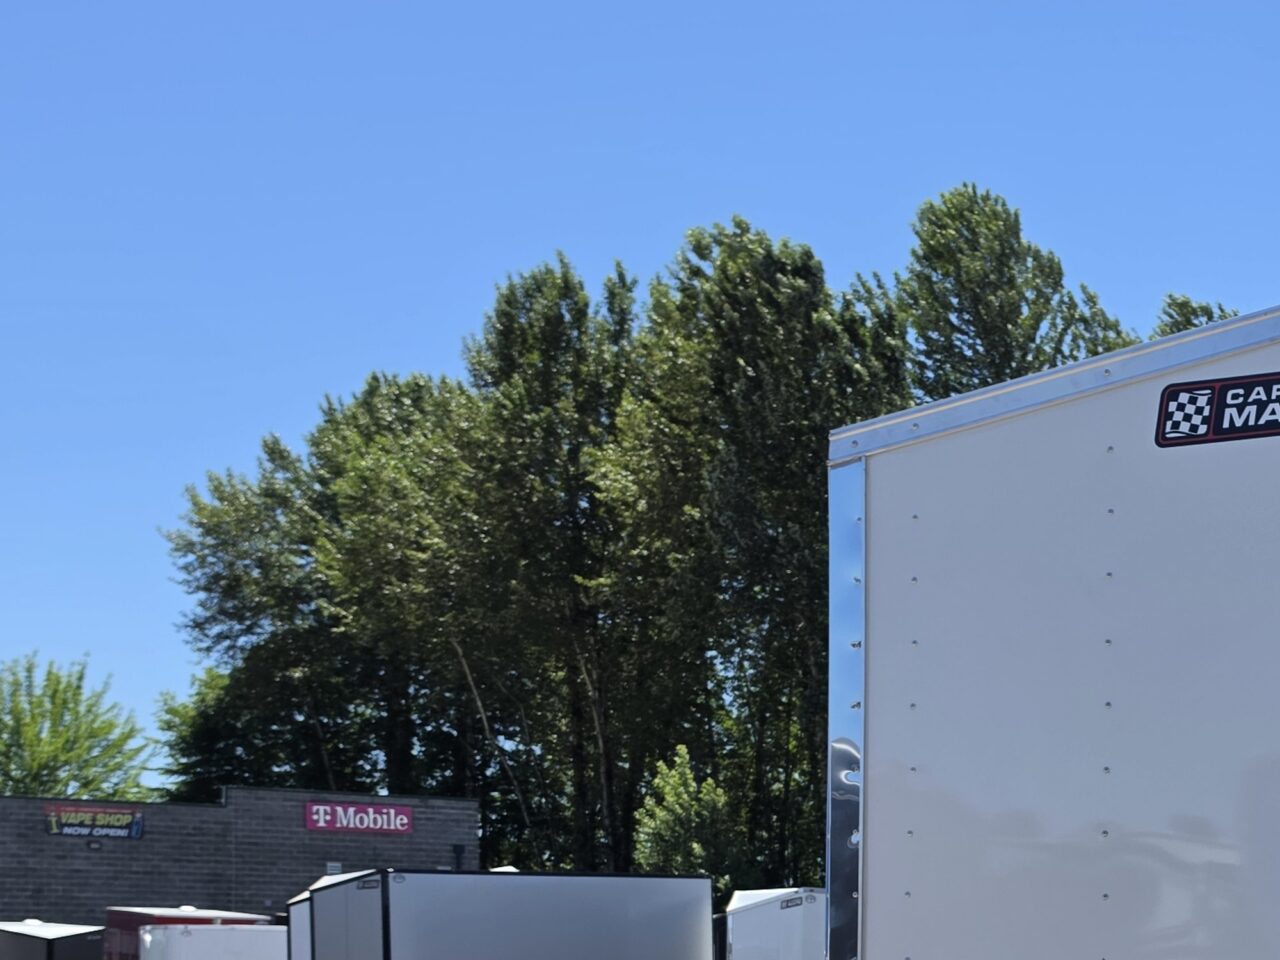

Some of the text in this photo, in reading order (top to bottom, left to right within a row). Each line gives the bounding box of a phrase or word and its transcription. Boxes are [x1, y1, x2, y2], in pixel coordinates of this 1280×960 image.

[60, 812, 133, 827] VAPE SHOP
[335, 806, 409, 830] Mobile
[62, 826, 91, 836] NOW
